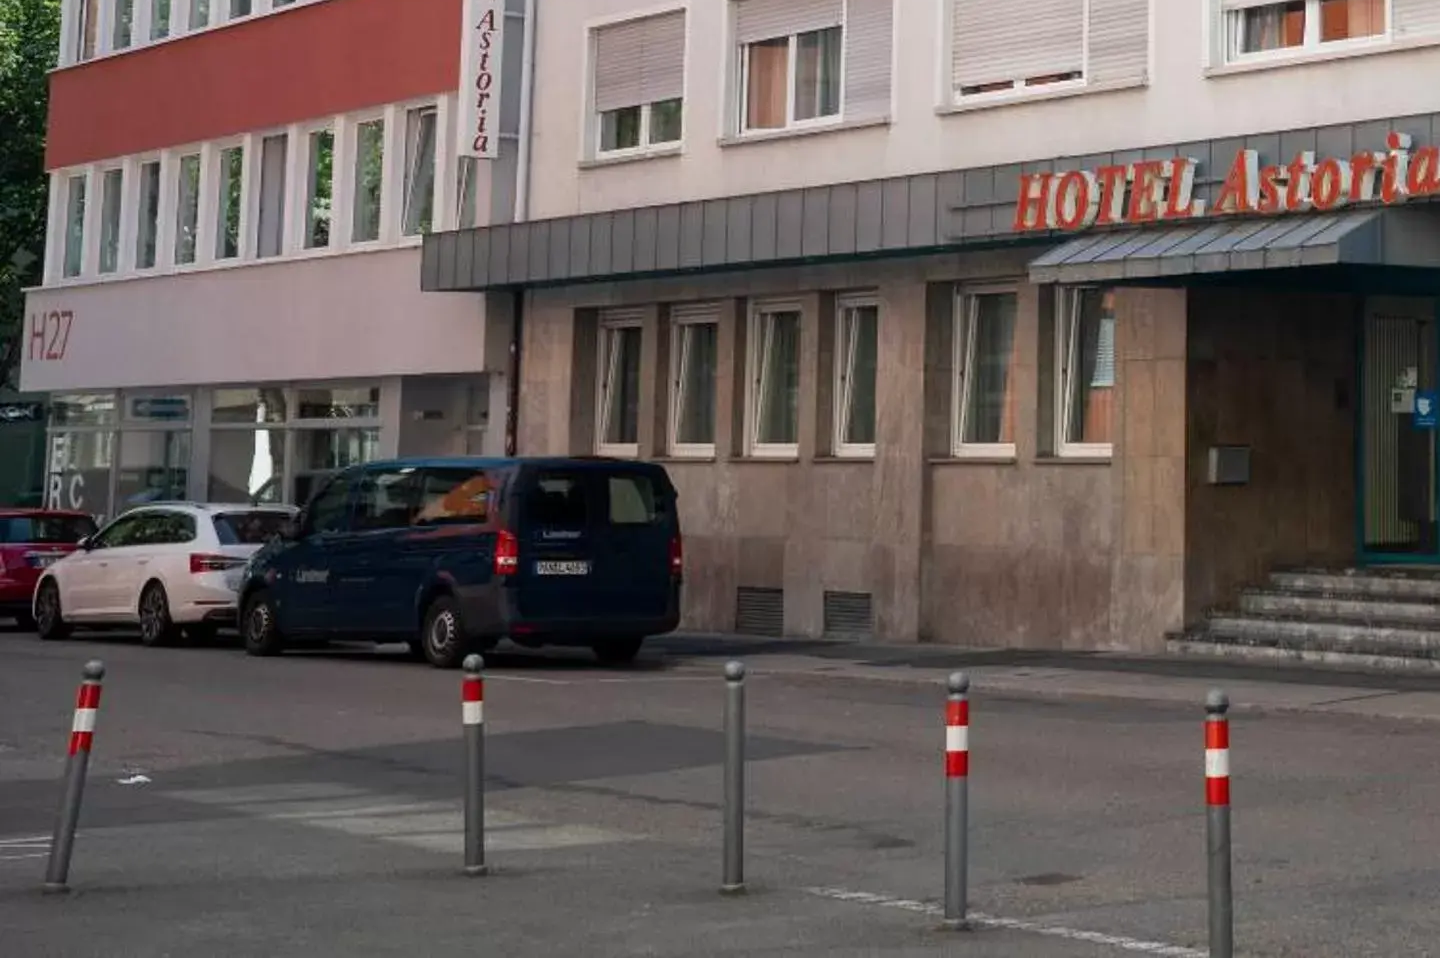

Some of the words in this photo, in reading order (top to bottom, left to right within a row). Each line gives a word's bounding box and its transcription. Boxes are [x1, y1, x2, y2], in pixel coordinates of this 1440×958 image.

[472, 8, 498, 153] Astoria
[1013, 155, 1206, 232] HOTEL
[29, 310, 74, 361] H27
